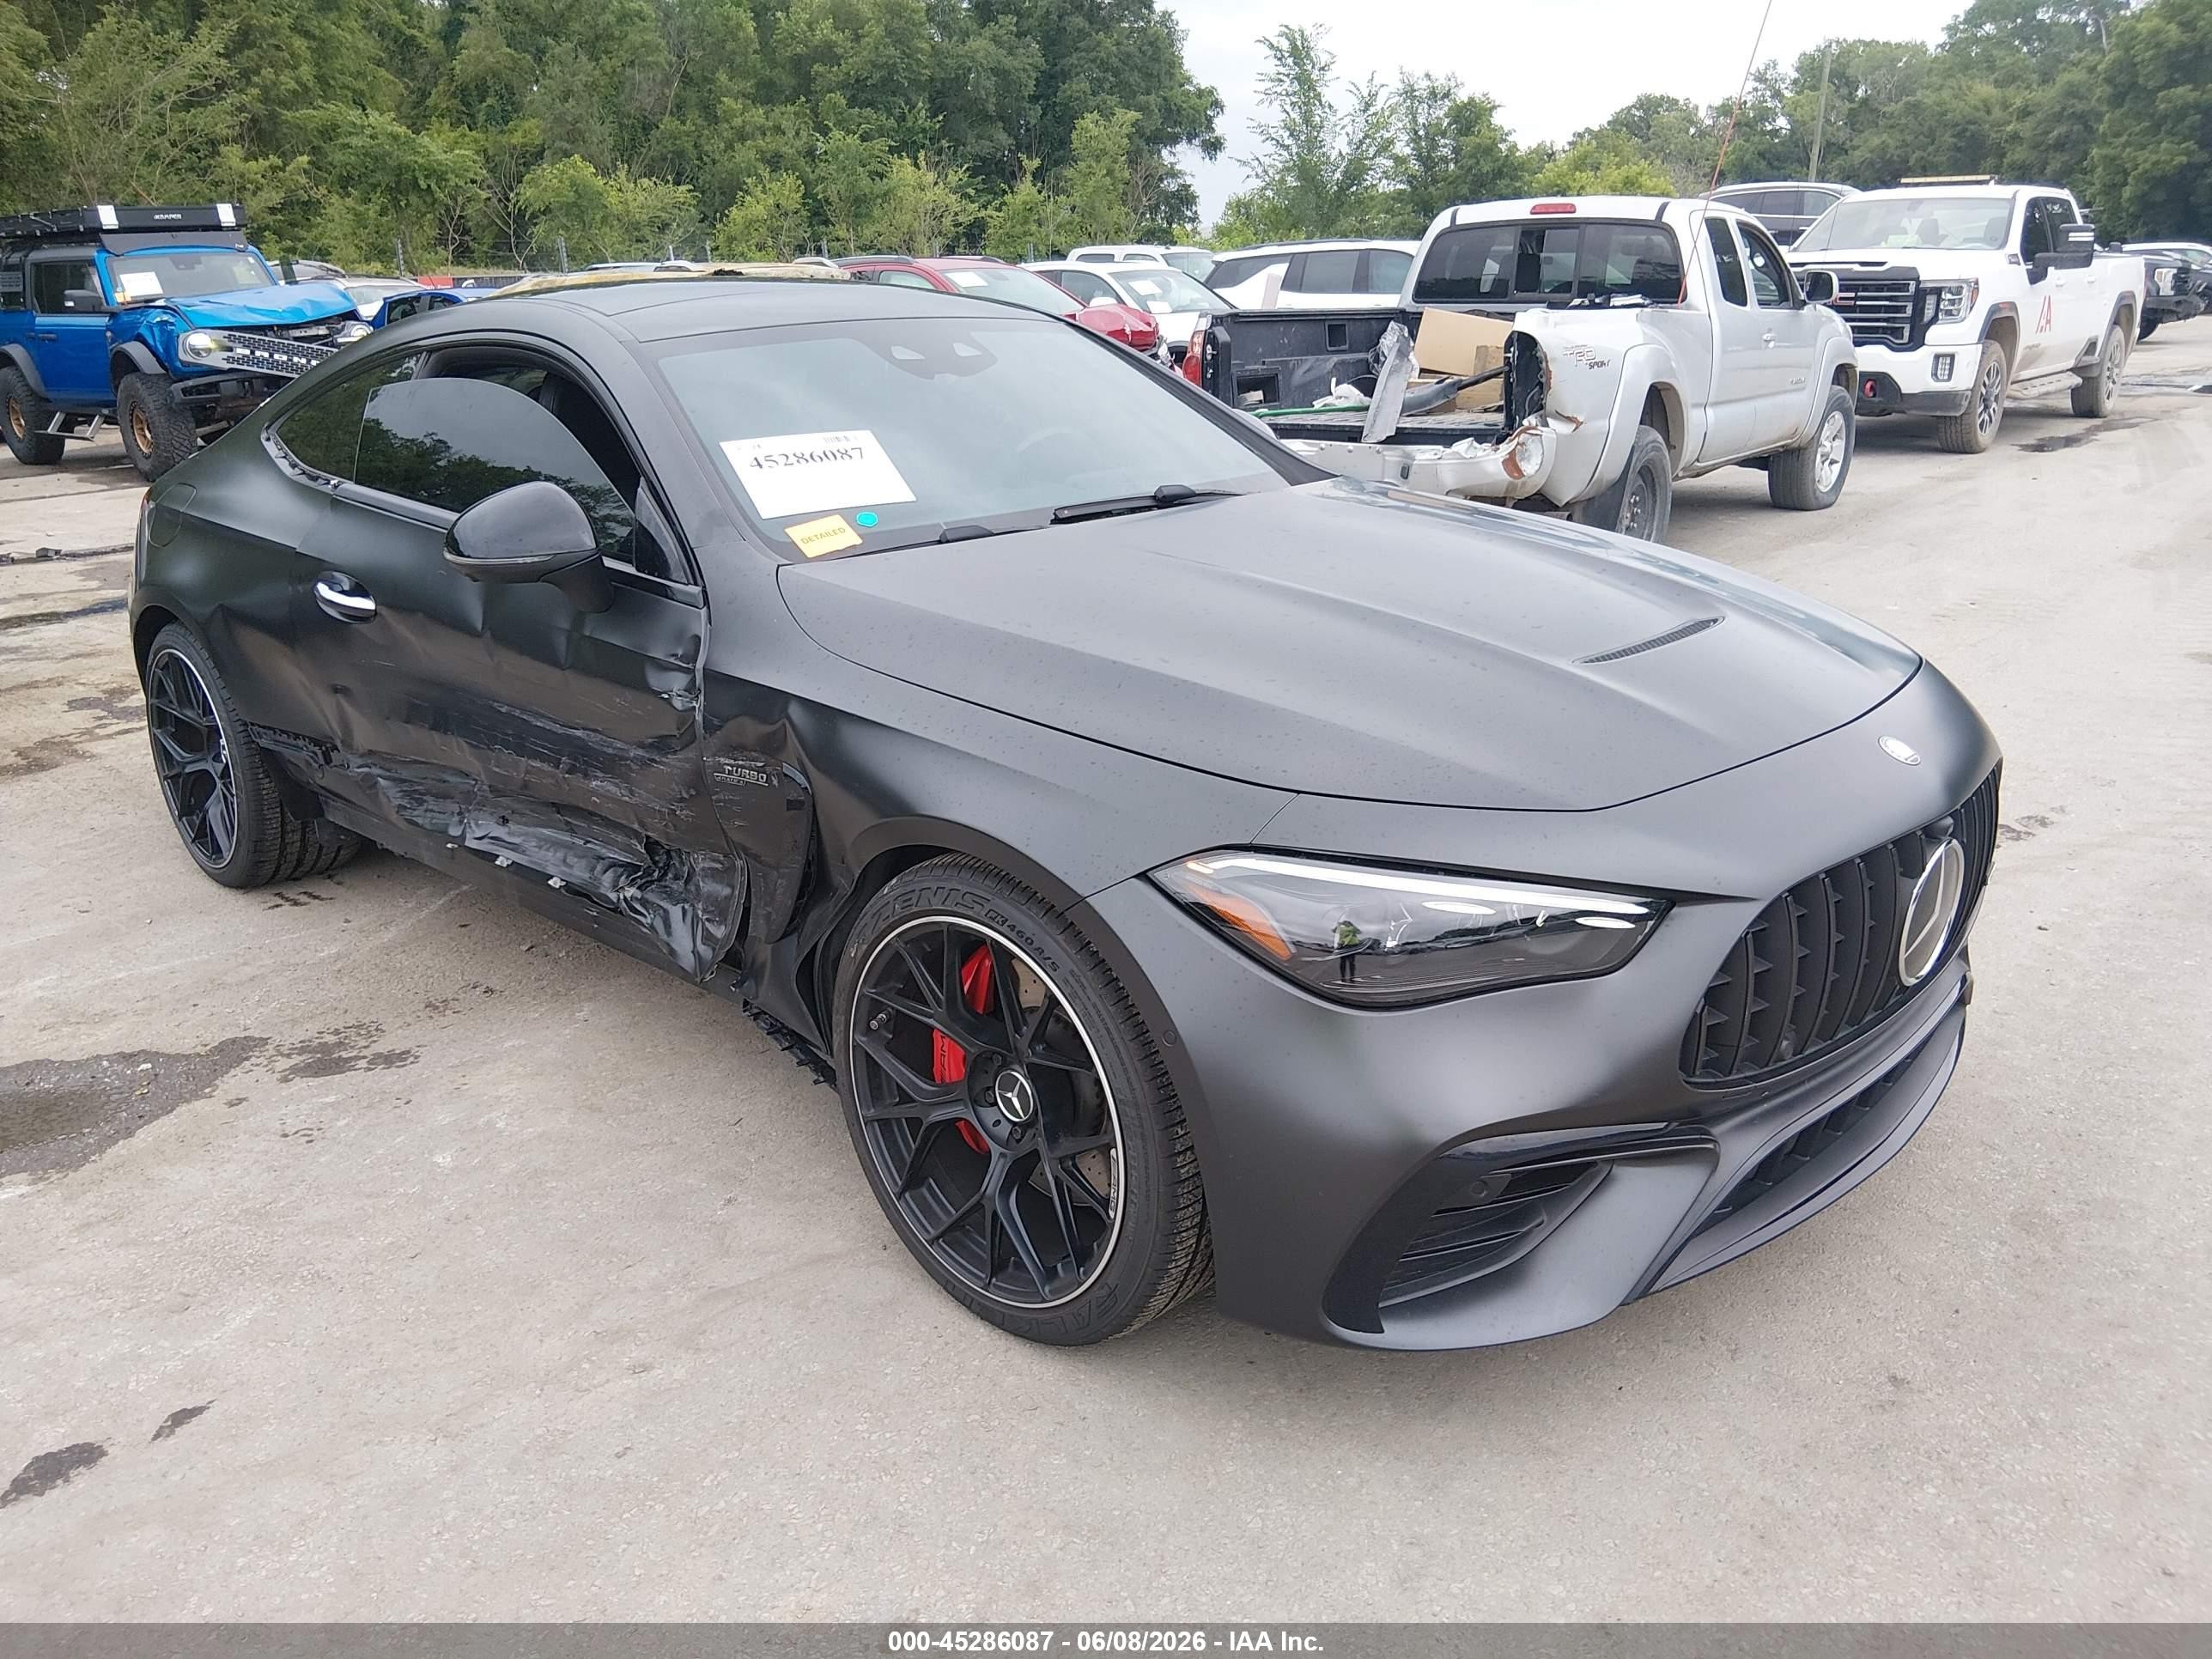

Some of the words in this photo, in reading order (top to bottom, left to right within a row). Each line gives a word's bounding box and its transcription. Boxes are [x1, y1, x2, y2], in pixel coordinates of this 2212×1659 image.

[1588, 360, 1611, 370] SPORT
[750, 447, 866, 470] 45286087
[800, 527, 846, 544] DETAILED
[723, 764, 767, 783] TURBO
